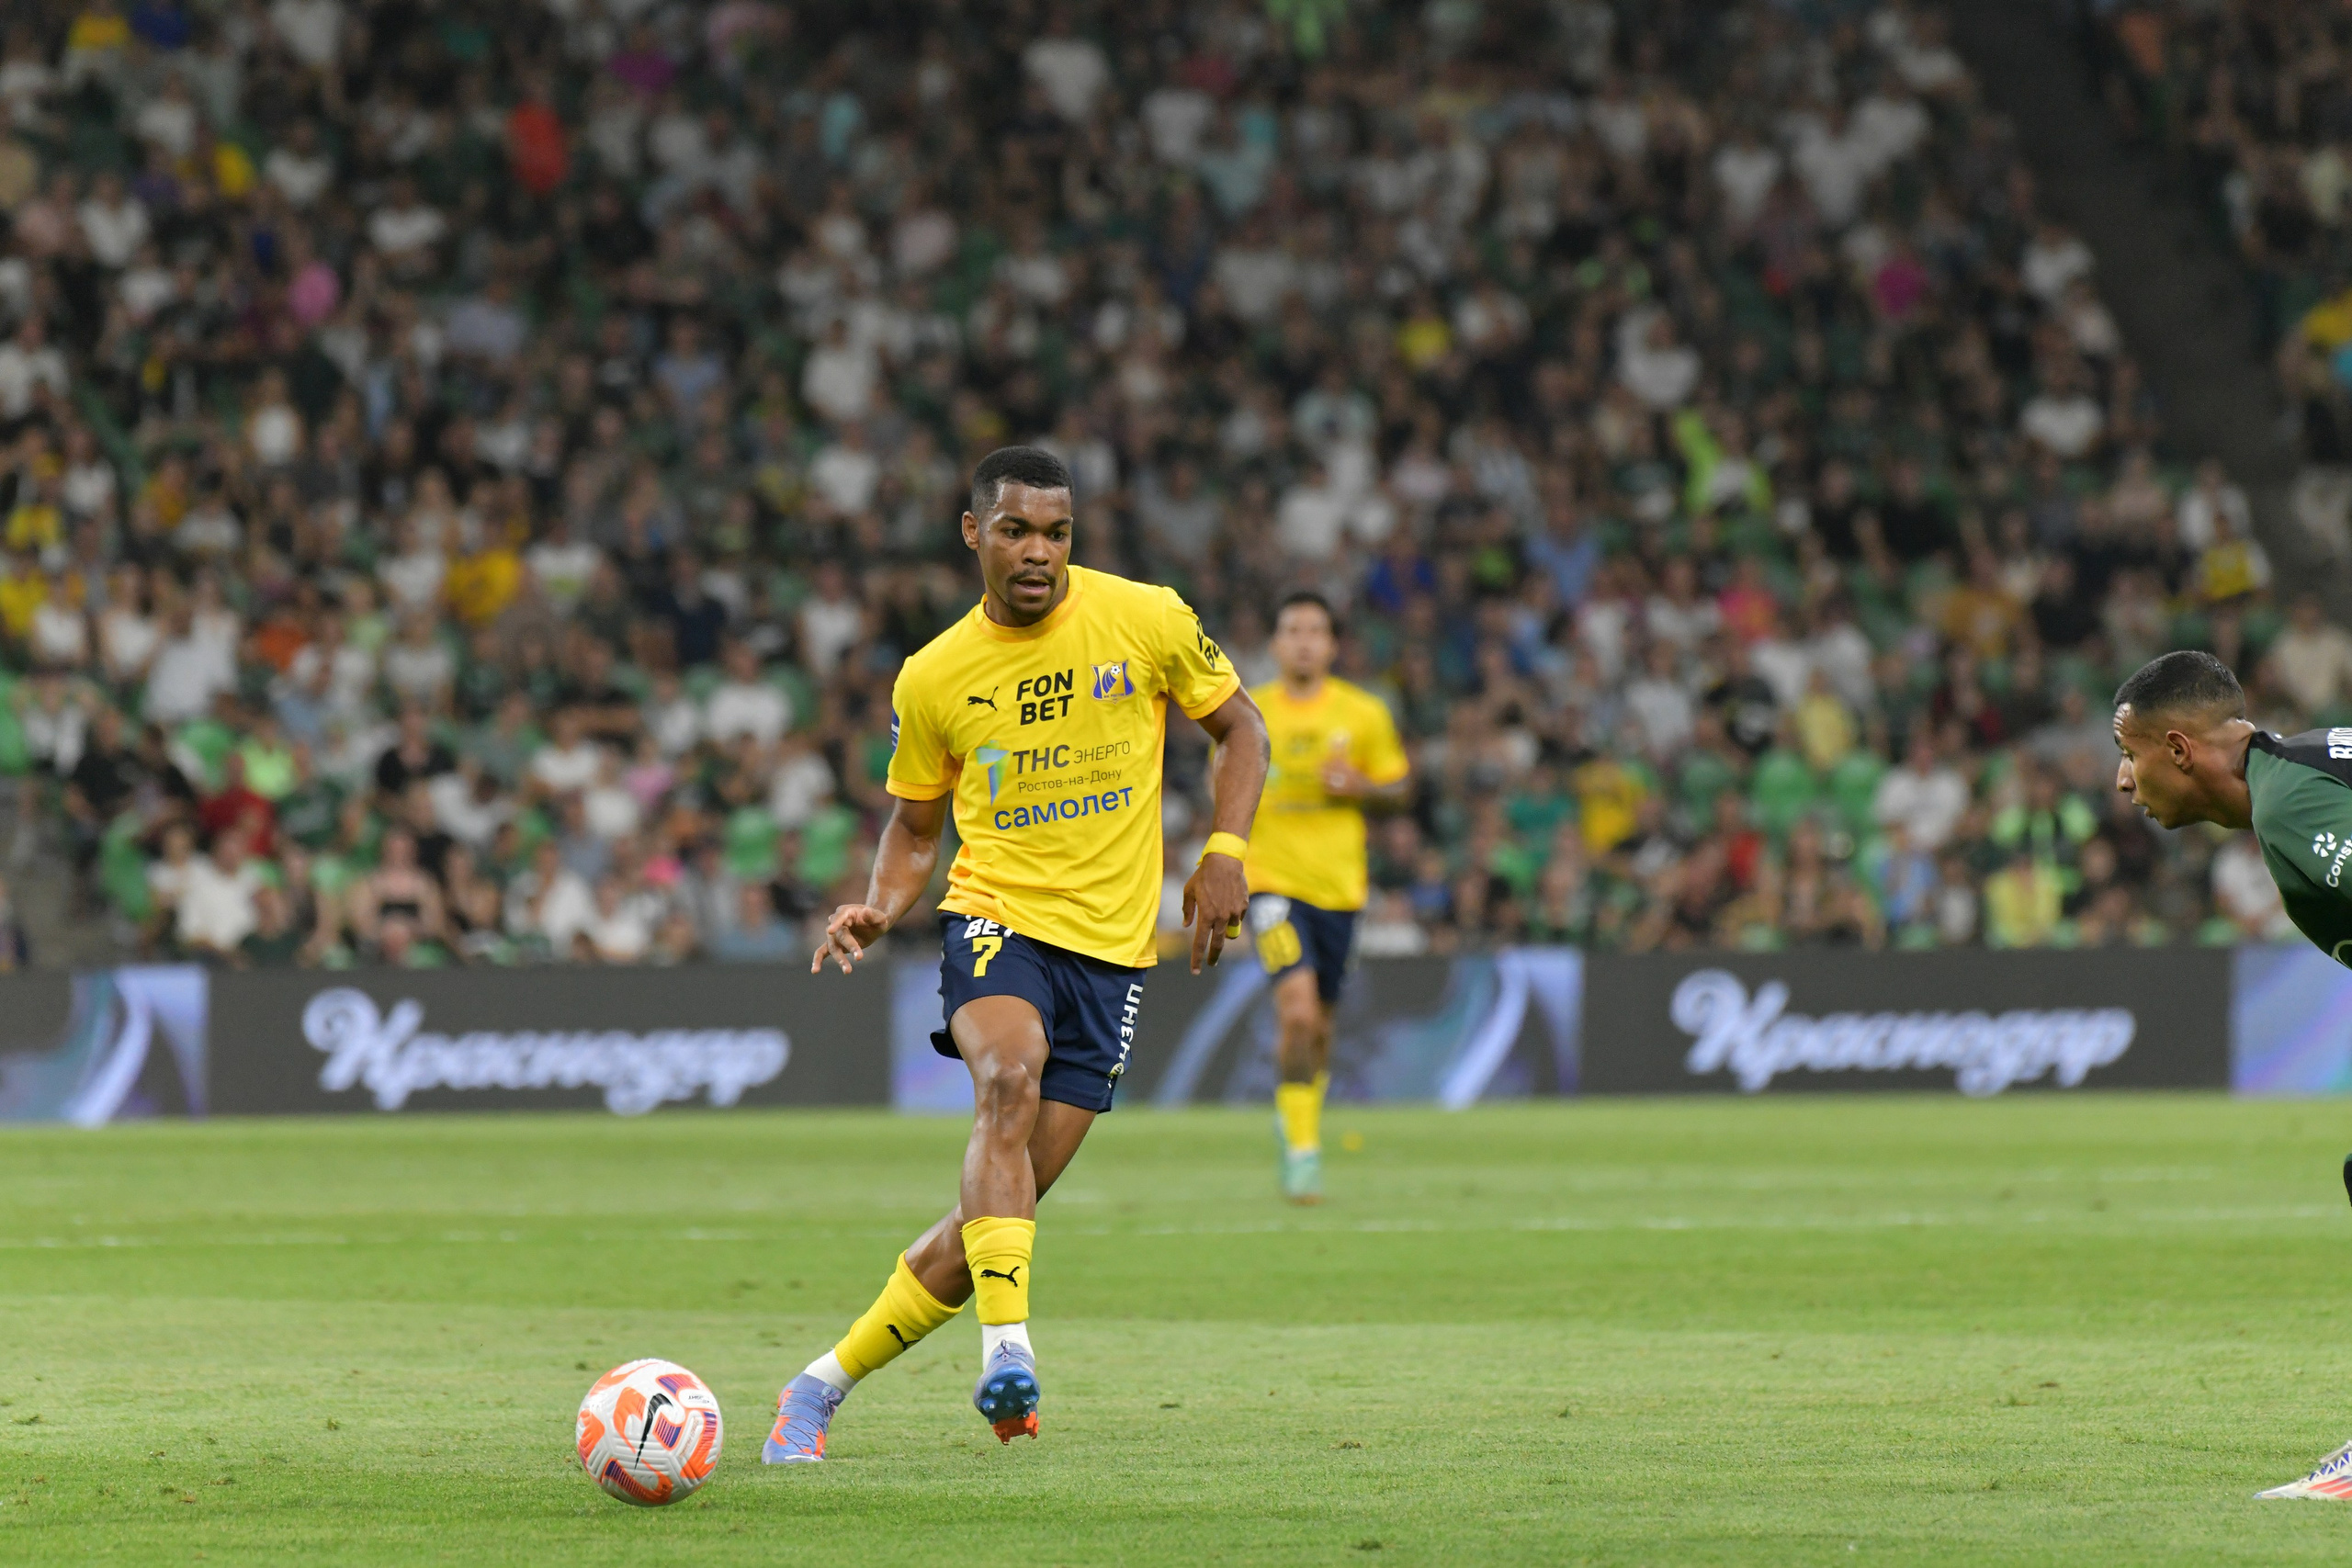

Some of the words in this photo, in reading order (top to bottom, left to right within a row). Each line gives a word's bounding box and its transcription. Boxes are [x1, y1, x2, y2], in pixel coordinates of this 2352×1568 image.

[1016, 669, 1073, 701] FON
[1020, 694, 1074, 726] BET
[1012, 745, 1070, 774] ТНС
[1073, 740, 1131, 764] ЭНЕРГО
[1018, 769, 1122, 793] Ростов-на-Дону
[994, 786, 1133, 830] самолет
[972, 935, 1003, 978] 7
[301, 986, 791, 1116] Краснодар
[1669, 967, 2137, 1097] Краснодар
